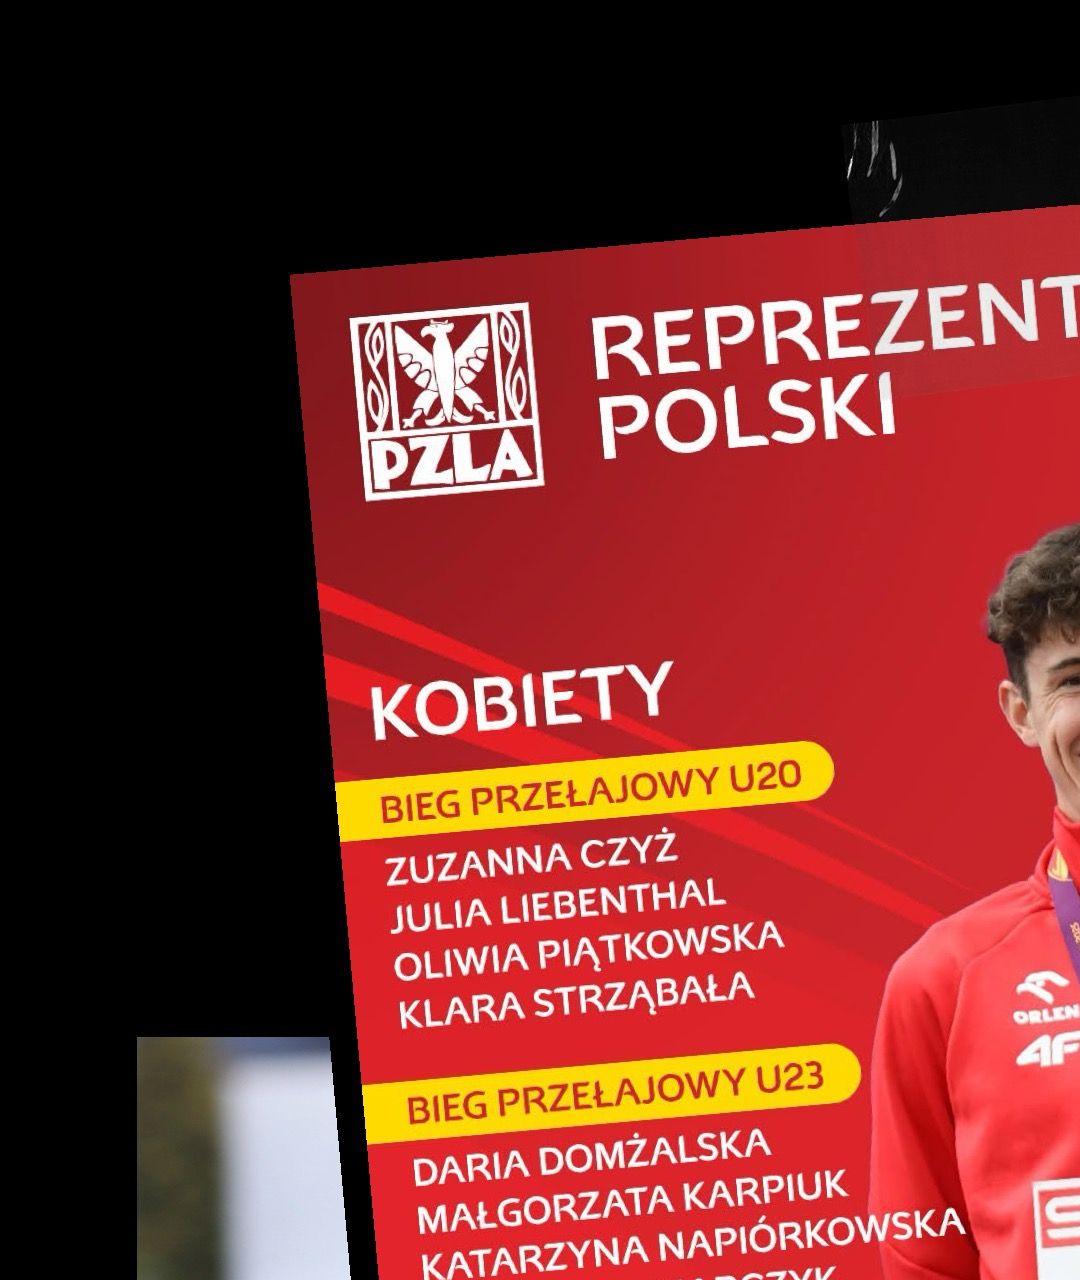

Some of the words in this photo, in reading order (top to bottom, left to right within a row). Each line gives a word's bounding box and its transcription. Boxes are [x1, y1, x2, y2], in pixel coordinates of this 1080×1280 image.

[598, 371, 896, 460] POLSKI
[370, 428, 534, 490] PZLA
[370, 660, 674, 741] KOBIETY
[380, 789, 461, 824] BIEG
[470, 766, 720, 816] PRZEŁAJOWY
[729, 759, 802, 793] U20
[384, 842, 573, 887] ZUZANNA
[580, 826, 679, 869] CZYŻ
[390, 898, 493, 935] JULIA
[500, 877, 727, 925] LIEBENTHAL
[393, 943, 530, 982] OLIWIA
[538, 920, 785, 972] PIĄTKOWSKA
[399, 991, 526, 1030] KLARA
[533, 970, 756, 1018] STRZĄBAŁA
[1012, 1003, 1080, 1025] ORLEN
[407, 1090, 488, 1126] BIEG
[497, 1067, 746, 1117] PRZEŁAJOWY
[756, 1060, 824, 1094] U23
[413, 1149, 531, 1187] DARIA
[538, 1128, 772, 1176] DOMŻALSKA
[417, 1185, 675, 1235] MAŁGORZATA
[682, 1168, 849, 1211] KARPIUK
[658, 1207, 966, 1262] NAPIÓRKOWSKA
